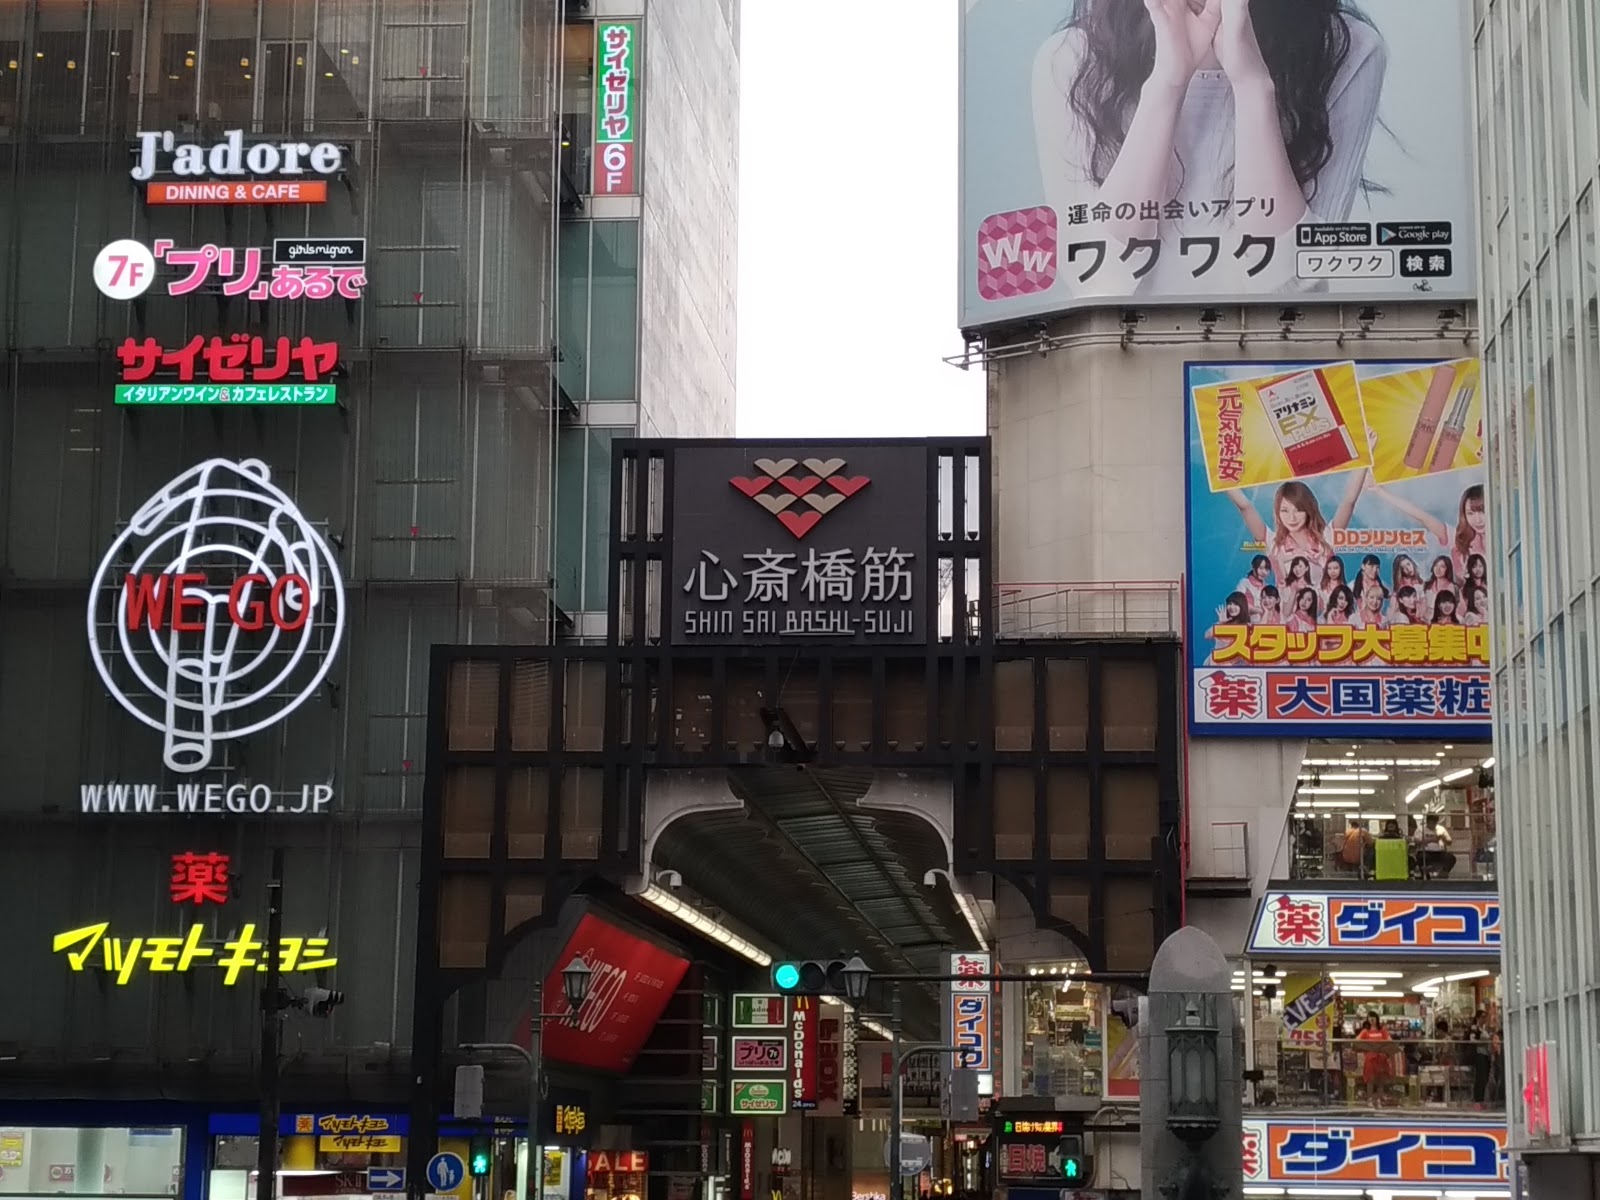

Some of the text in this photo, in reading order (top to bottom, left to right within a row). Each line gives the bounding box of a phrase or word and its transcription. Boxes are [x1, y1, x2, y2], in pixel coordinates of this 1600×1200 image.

[603, 27, 630, 138] サイゼリヤ
[131, 129, 341, 180] J'adore
[603, 143, 626, 192] 6F
[166, 185, 300, 200] DINING & CAFE
[1067, 198, 1275, 226] 運命の出会いアプリ
[1314, 232, 1367, 245] App Store
[1398, 229, 1449, 241] Google play
[107, 254, 145, 287] 7F
[1067, 234, 1276, 283] ワクワク
[1308, 255, 1383, 273] ワクワク
[1406, 255, 1446, 272] 検索
[117, 334, 338, 381] サイゼリヤ
[1273, 396, 1316, 419] アリナミン
[1278, 405, 1320, 436] EX
[1217, 386, 1244, 483] 元気激安
[1333, 529, 1427, 547] DDプリンセス
[683, 547, 915, 602] 心斎橋筋
[125, 574, 311, 631] WE GO
[685, 611, 733, 633] SHIN
[743, 611, 776, 633] SAI
[1200, 671, 1262, 718] 薬
[81, 784, 334, 813] WWW.WEGO.JP
[170, 852, 230, 903] 薬
[1274, 898, 1324, 945] 薬
[53, 922, 338, 985] マツモトキヨシ
[956, 955, 986, 989] 薬
[739, 1045, 766, 1060] プリ
[740, 1099, 777, 1109] サイゼリヤ
[319, 1115, 389, 1132] マツモトキヨシ
[332, 1136, 389, 1149] マツモトキヨシ
[1279, 1128, 1507, 1178] ダイコ
[588, 1151, 645, 1171] ALE
